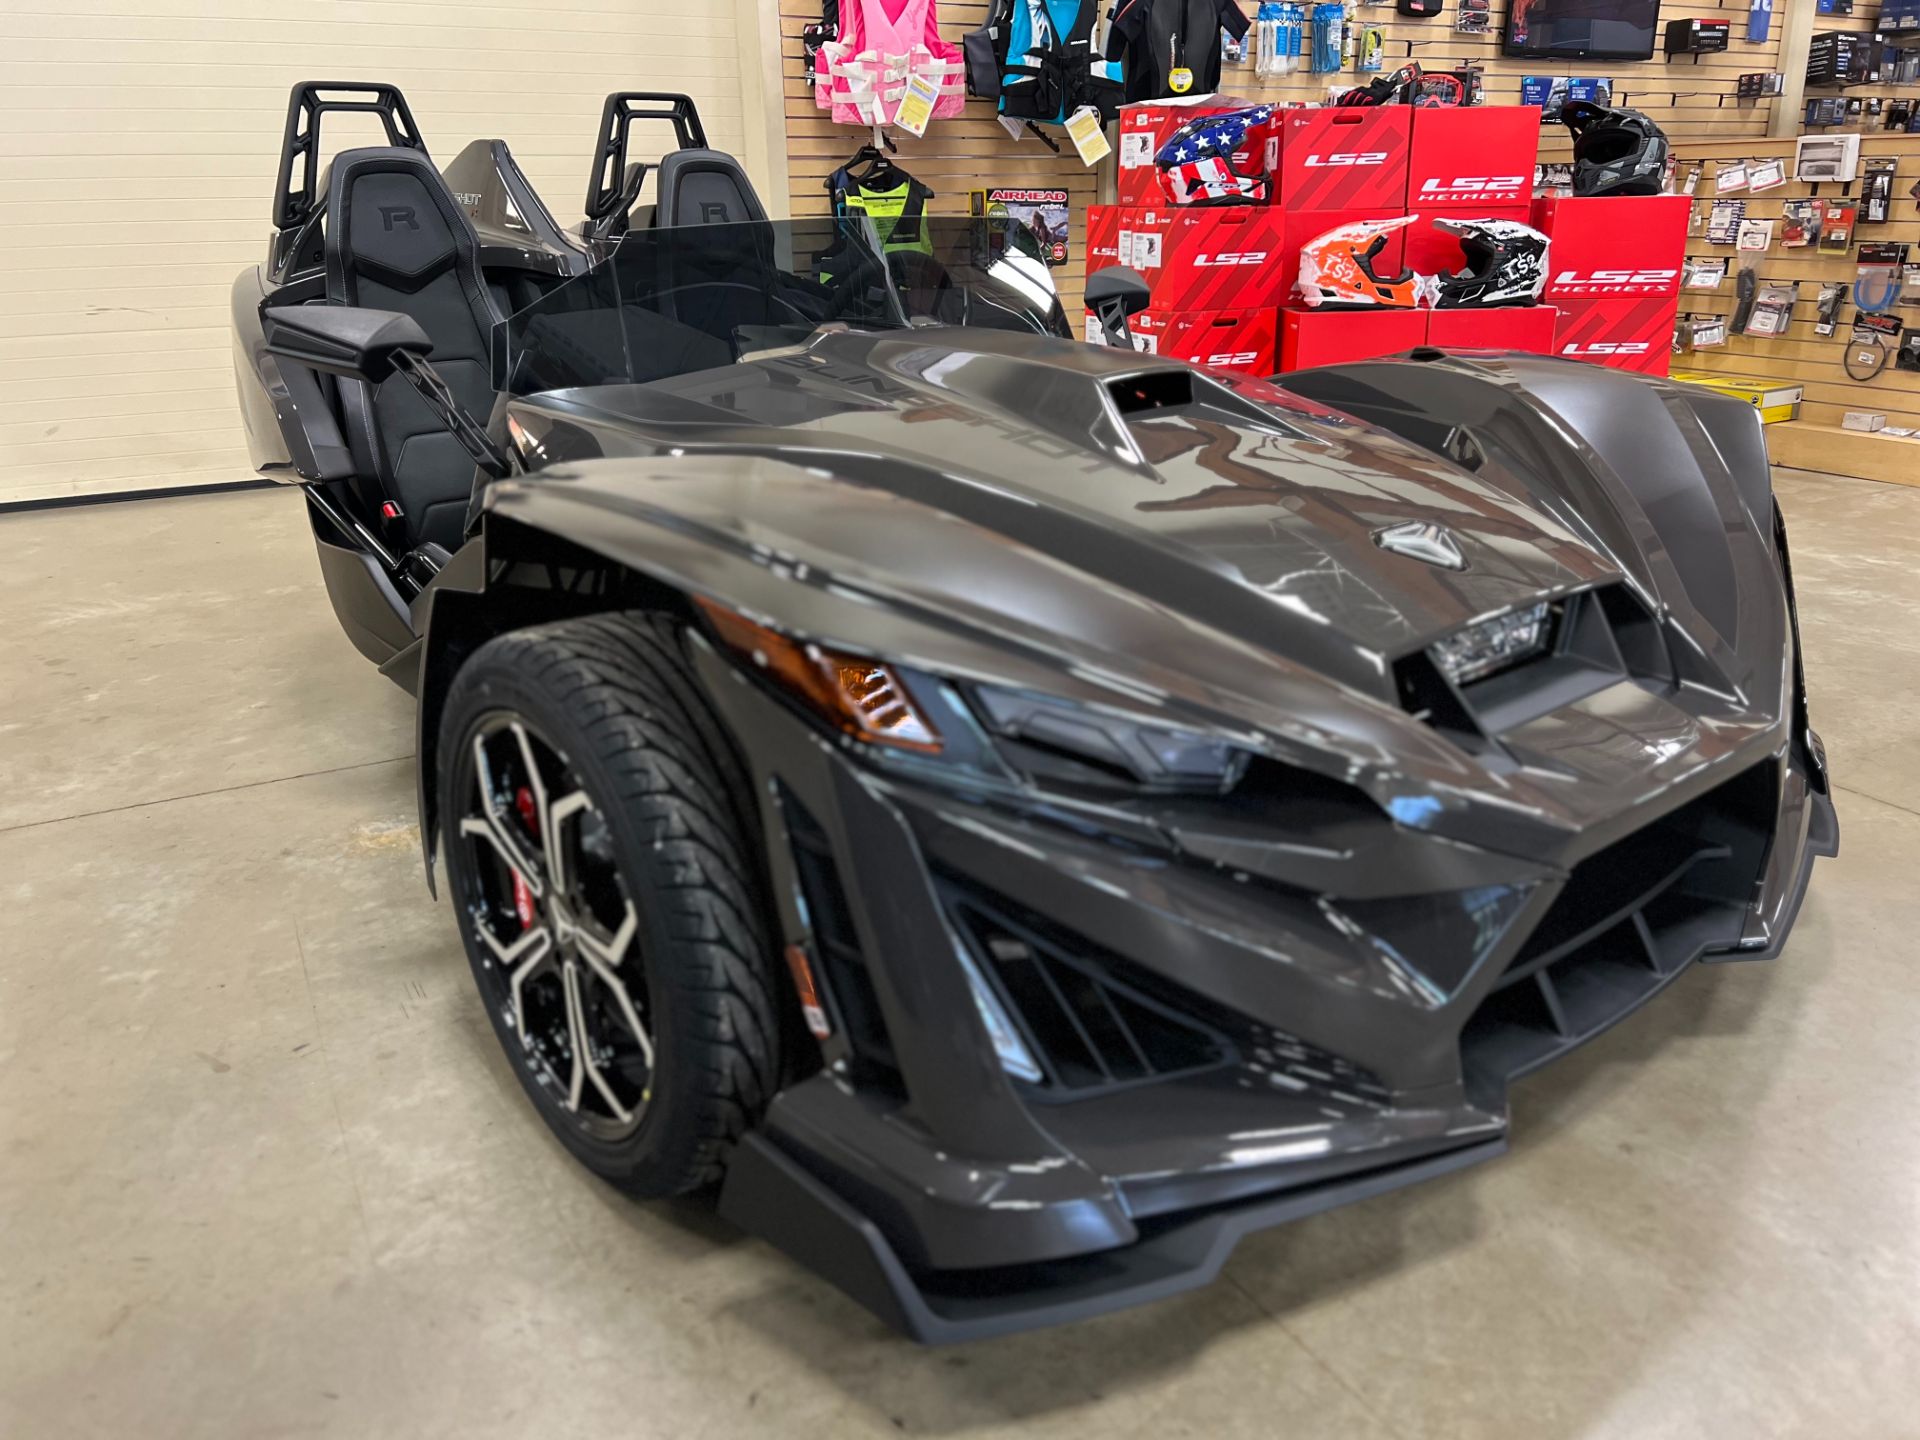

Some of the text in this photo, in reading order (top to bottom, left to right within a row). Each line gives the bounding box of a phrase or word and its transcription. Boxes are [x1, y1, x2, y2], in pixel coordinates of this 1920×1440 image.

[1303, 152, 1388, 167] LS2
[1421, 176, 1526, 192] LS2
[989, 190, 1068, 201] AIRHEAD
[1418, 192, 1518, 201] HELMETS
[1193, 252, 1267, 267] LS2
[1504, 253, 1537, 280] LS2
[1554, 269, 1678, 284] LS2
[1551, 285, 1671, 293] HELMETS
[1562, 342, 1649, 354] LS2
